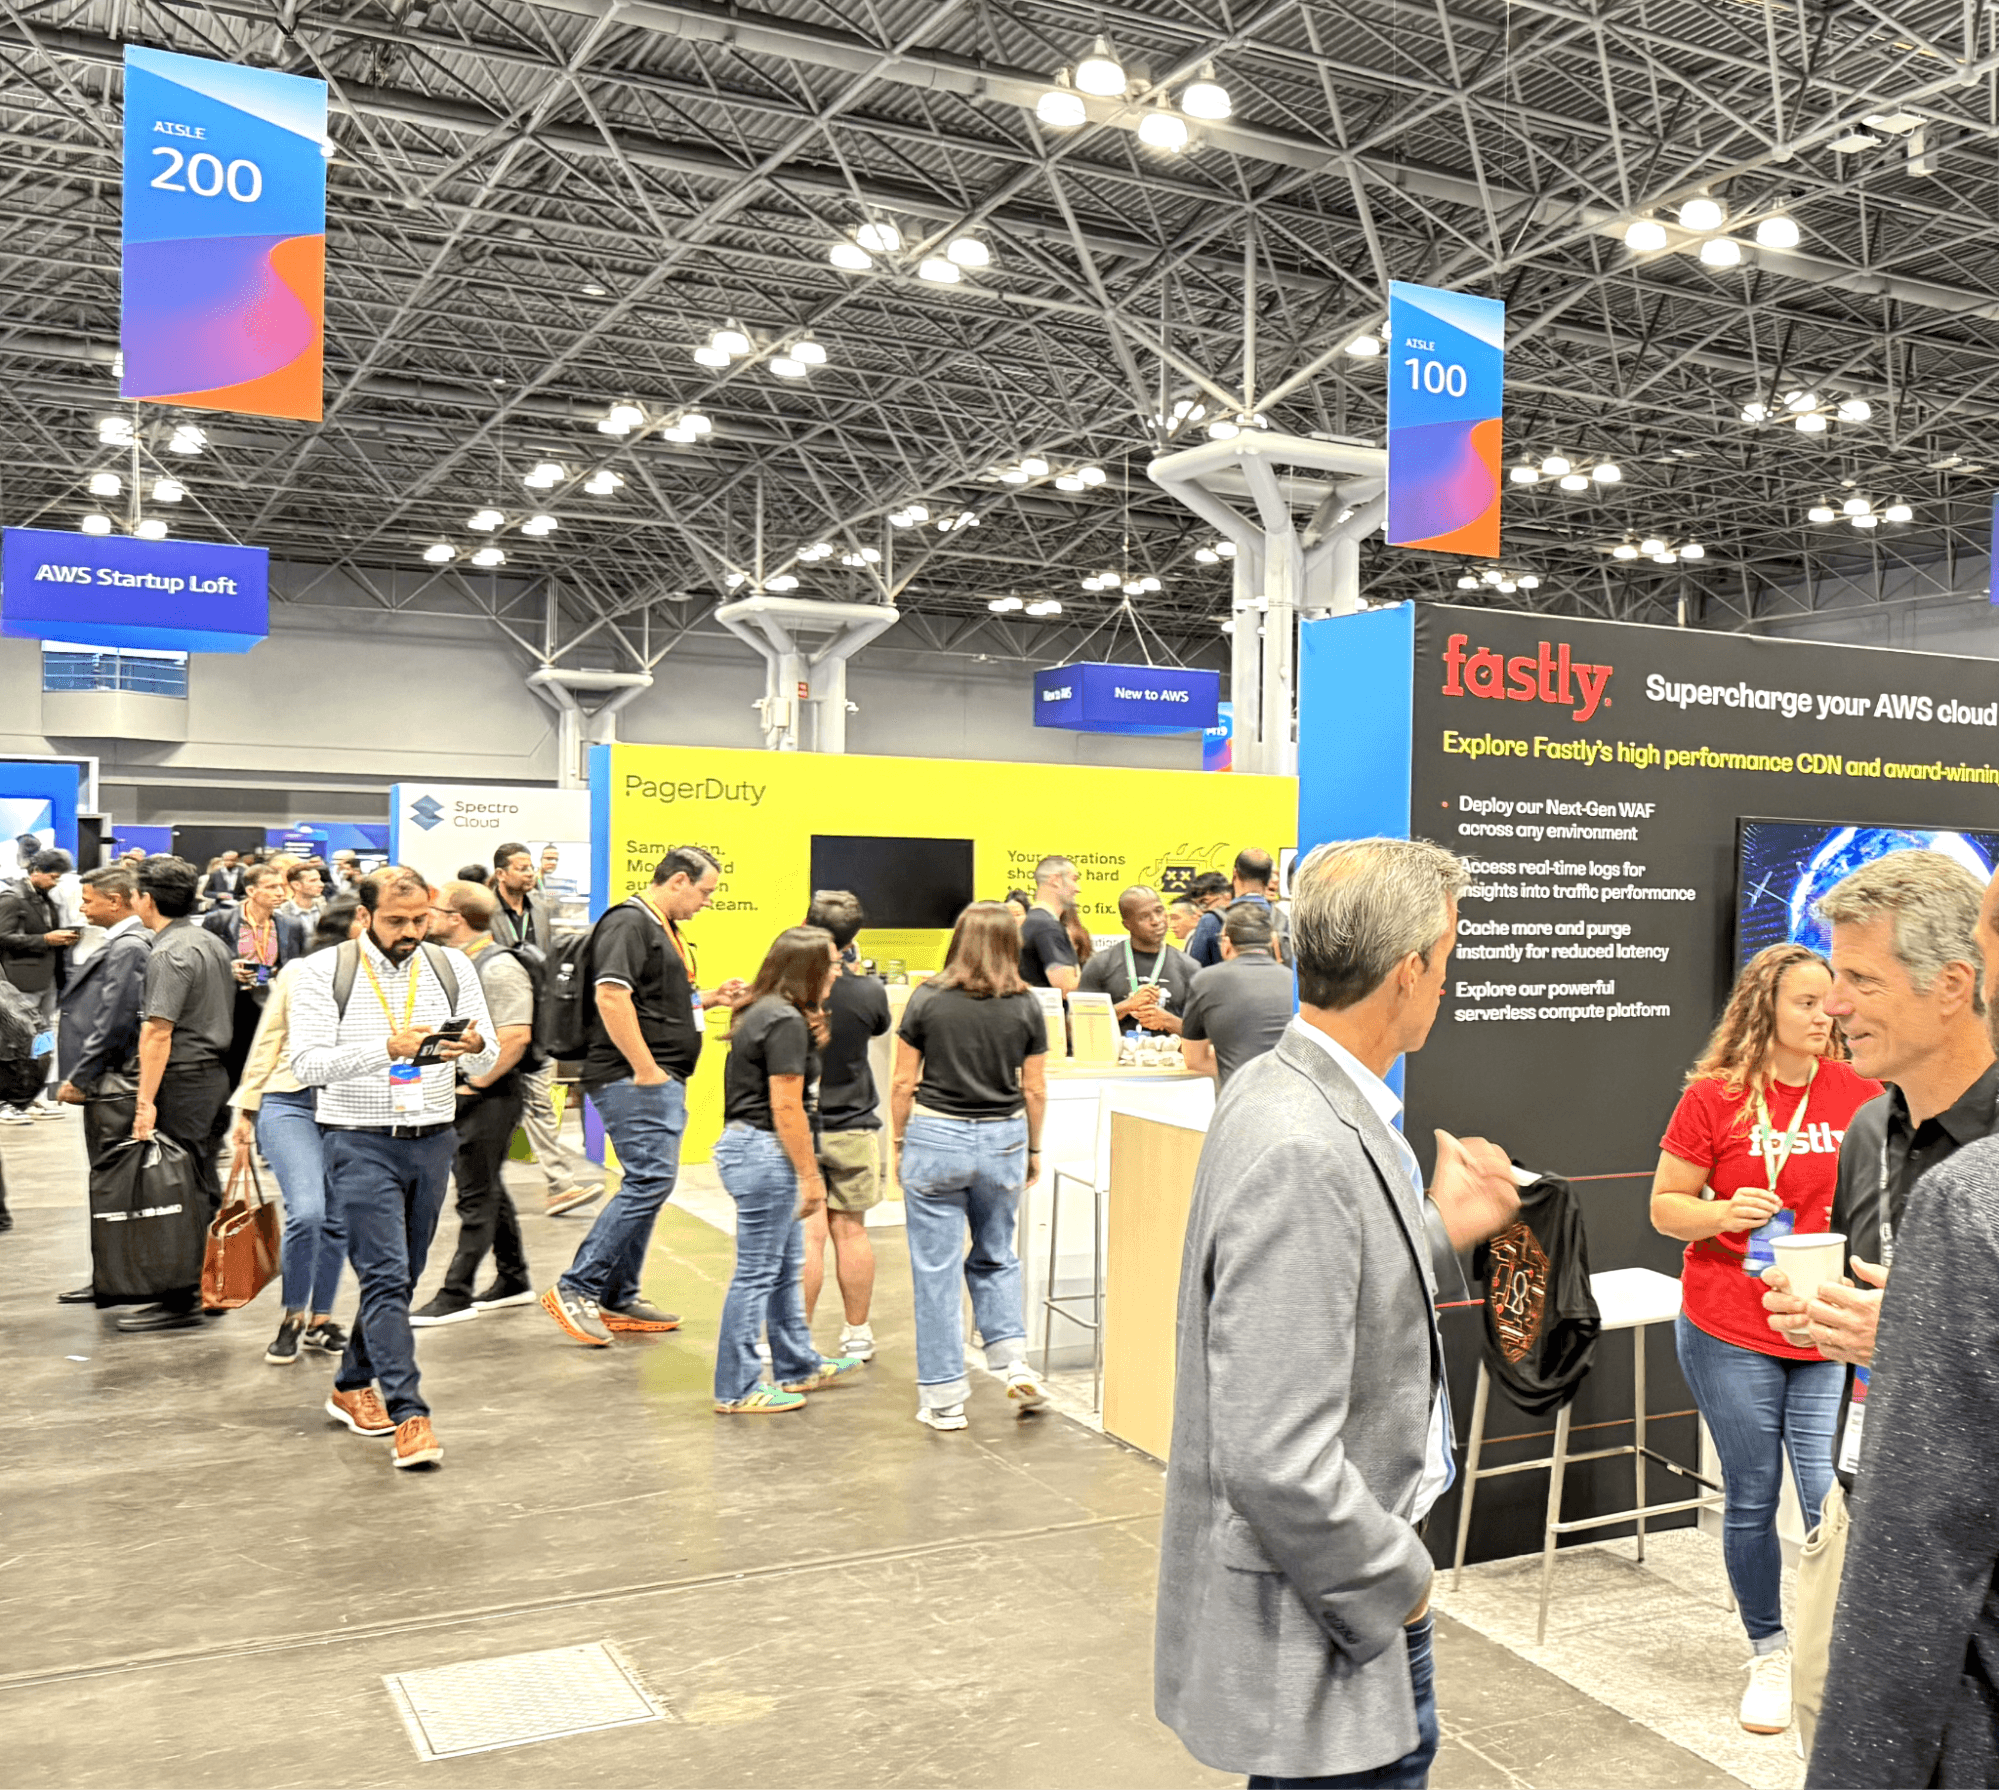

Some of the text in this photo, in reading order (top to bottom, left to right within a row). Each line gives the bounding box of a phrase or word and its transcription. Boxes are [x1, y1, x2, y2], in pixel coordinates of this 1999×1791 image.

[153, 121, 207, 140] AISLE
[150, 146, 262, 203] 200
[1405, 338, 1436, 352] AISLE
[1404, 358, 1467, 397] 100
[34, 564, 238, 595] AWS Startup Loft
[1114, 686, 1189, 703] New to AWS
[1645, 673, 1998, 726] Supercharge your AWS cloud
[1443, 730, 1999, 787] Explore Fastly's high performance CDN and award-winnin
[625, 774, 766, 806] PagerDuty
[454, 801, 519, 814] Spectro
[1459, 795, 1656, 818] Deploy our Next-Gen WAF
[453, 816, 500, 828] Cloud
[1458, 822, 1638, 841] across any environment
[1086, 869, 1119, 881] hard
[1461, 858, 1646, 880] Access real-time logs for
[1460, 882, 1696, 902] nsights into traffic performance
[1094, 903, 1116, 914] fix.
[1457, 919, 1631, 940] Cache more and purge
[1456, 943, 1669, 962] instantly for reduced latency
[1455, 979, 1615, 1001] Explore our powerful
[1454, 1001, 1670, 1022] serverless compute platform
